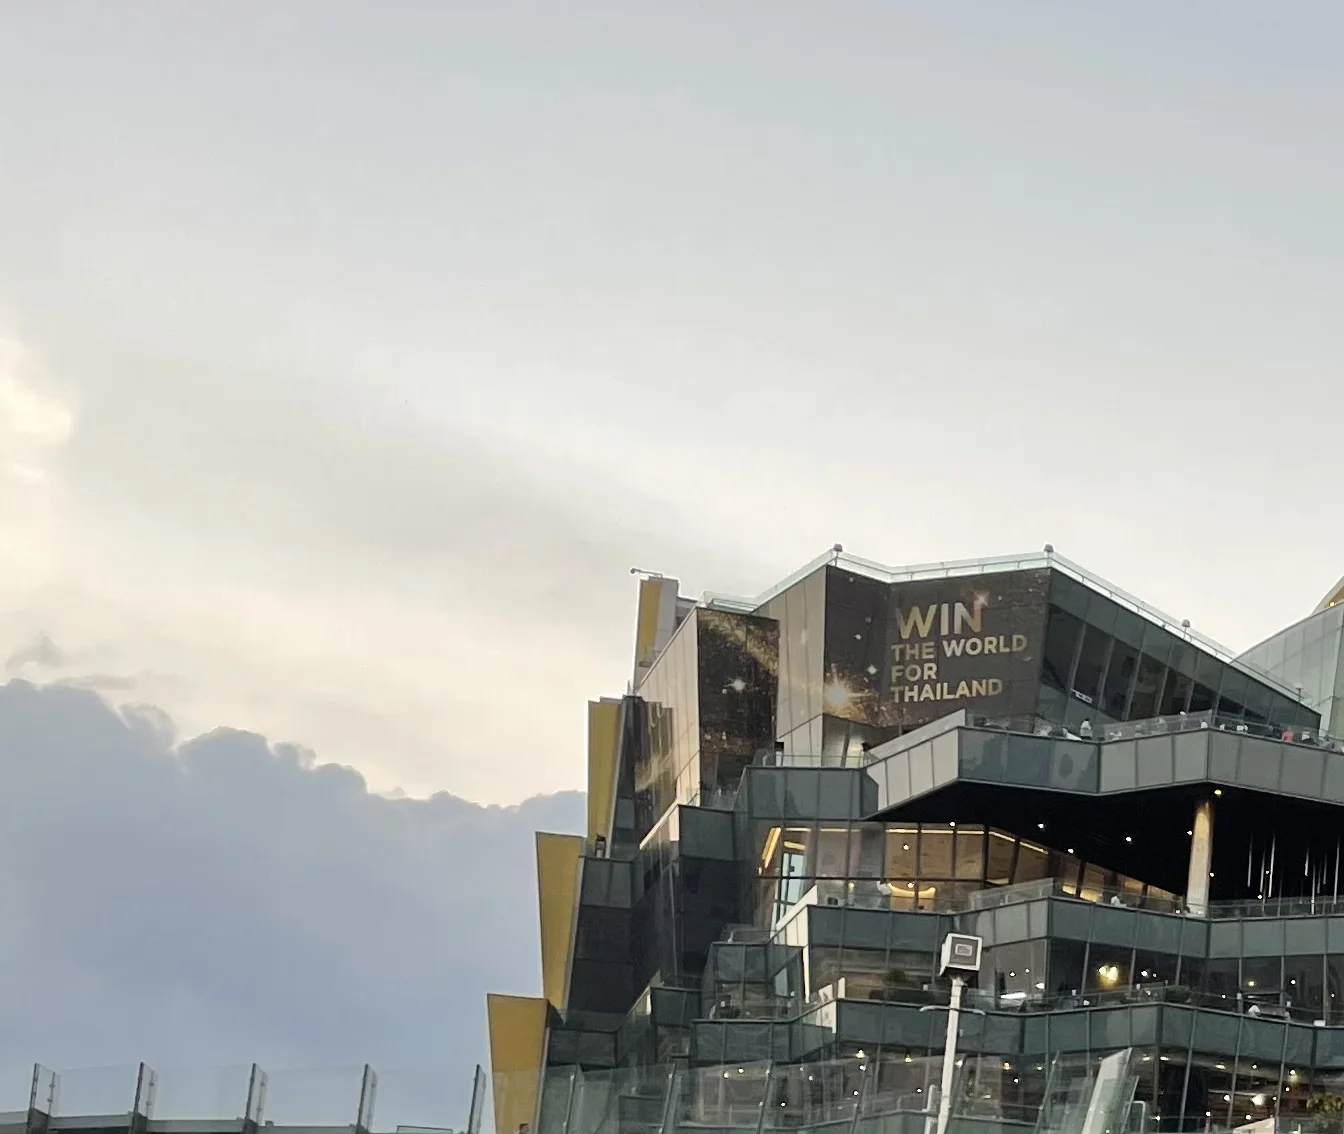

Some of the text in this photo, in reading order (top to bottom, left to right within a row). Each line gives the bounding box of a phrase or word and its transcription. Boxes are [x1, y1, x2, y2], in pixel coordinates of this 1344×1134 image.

[895, 601, 982, 639] WIN
[891, 634, 1028, 661] THE WORLD
[891, 662, 938, 682] FOR
[890, 678, 1003, 703] THAILAND
